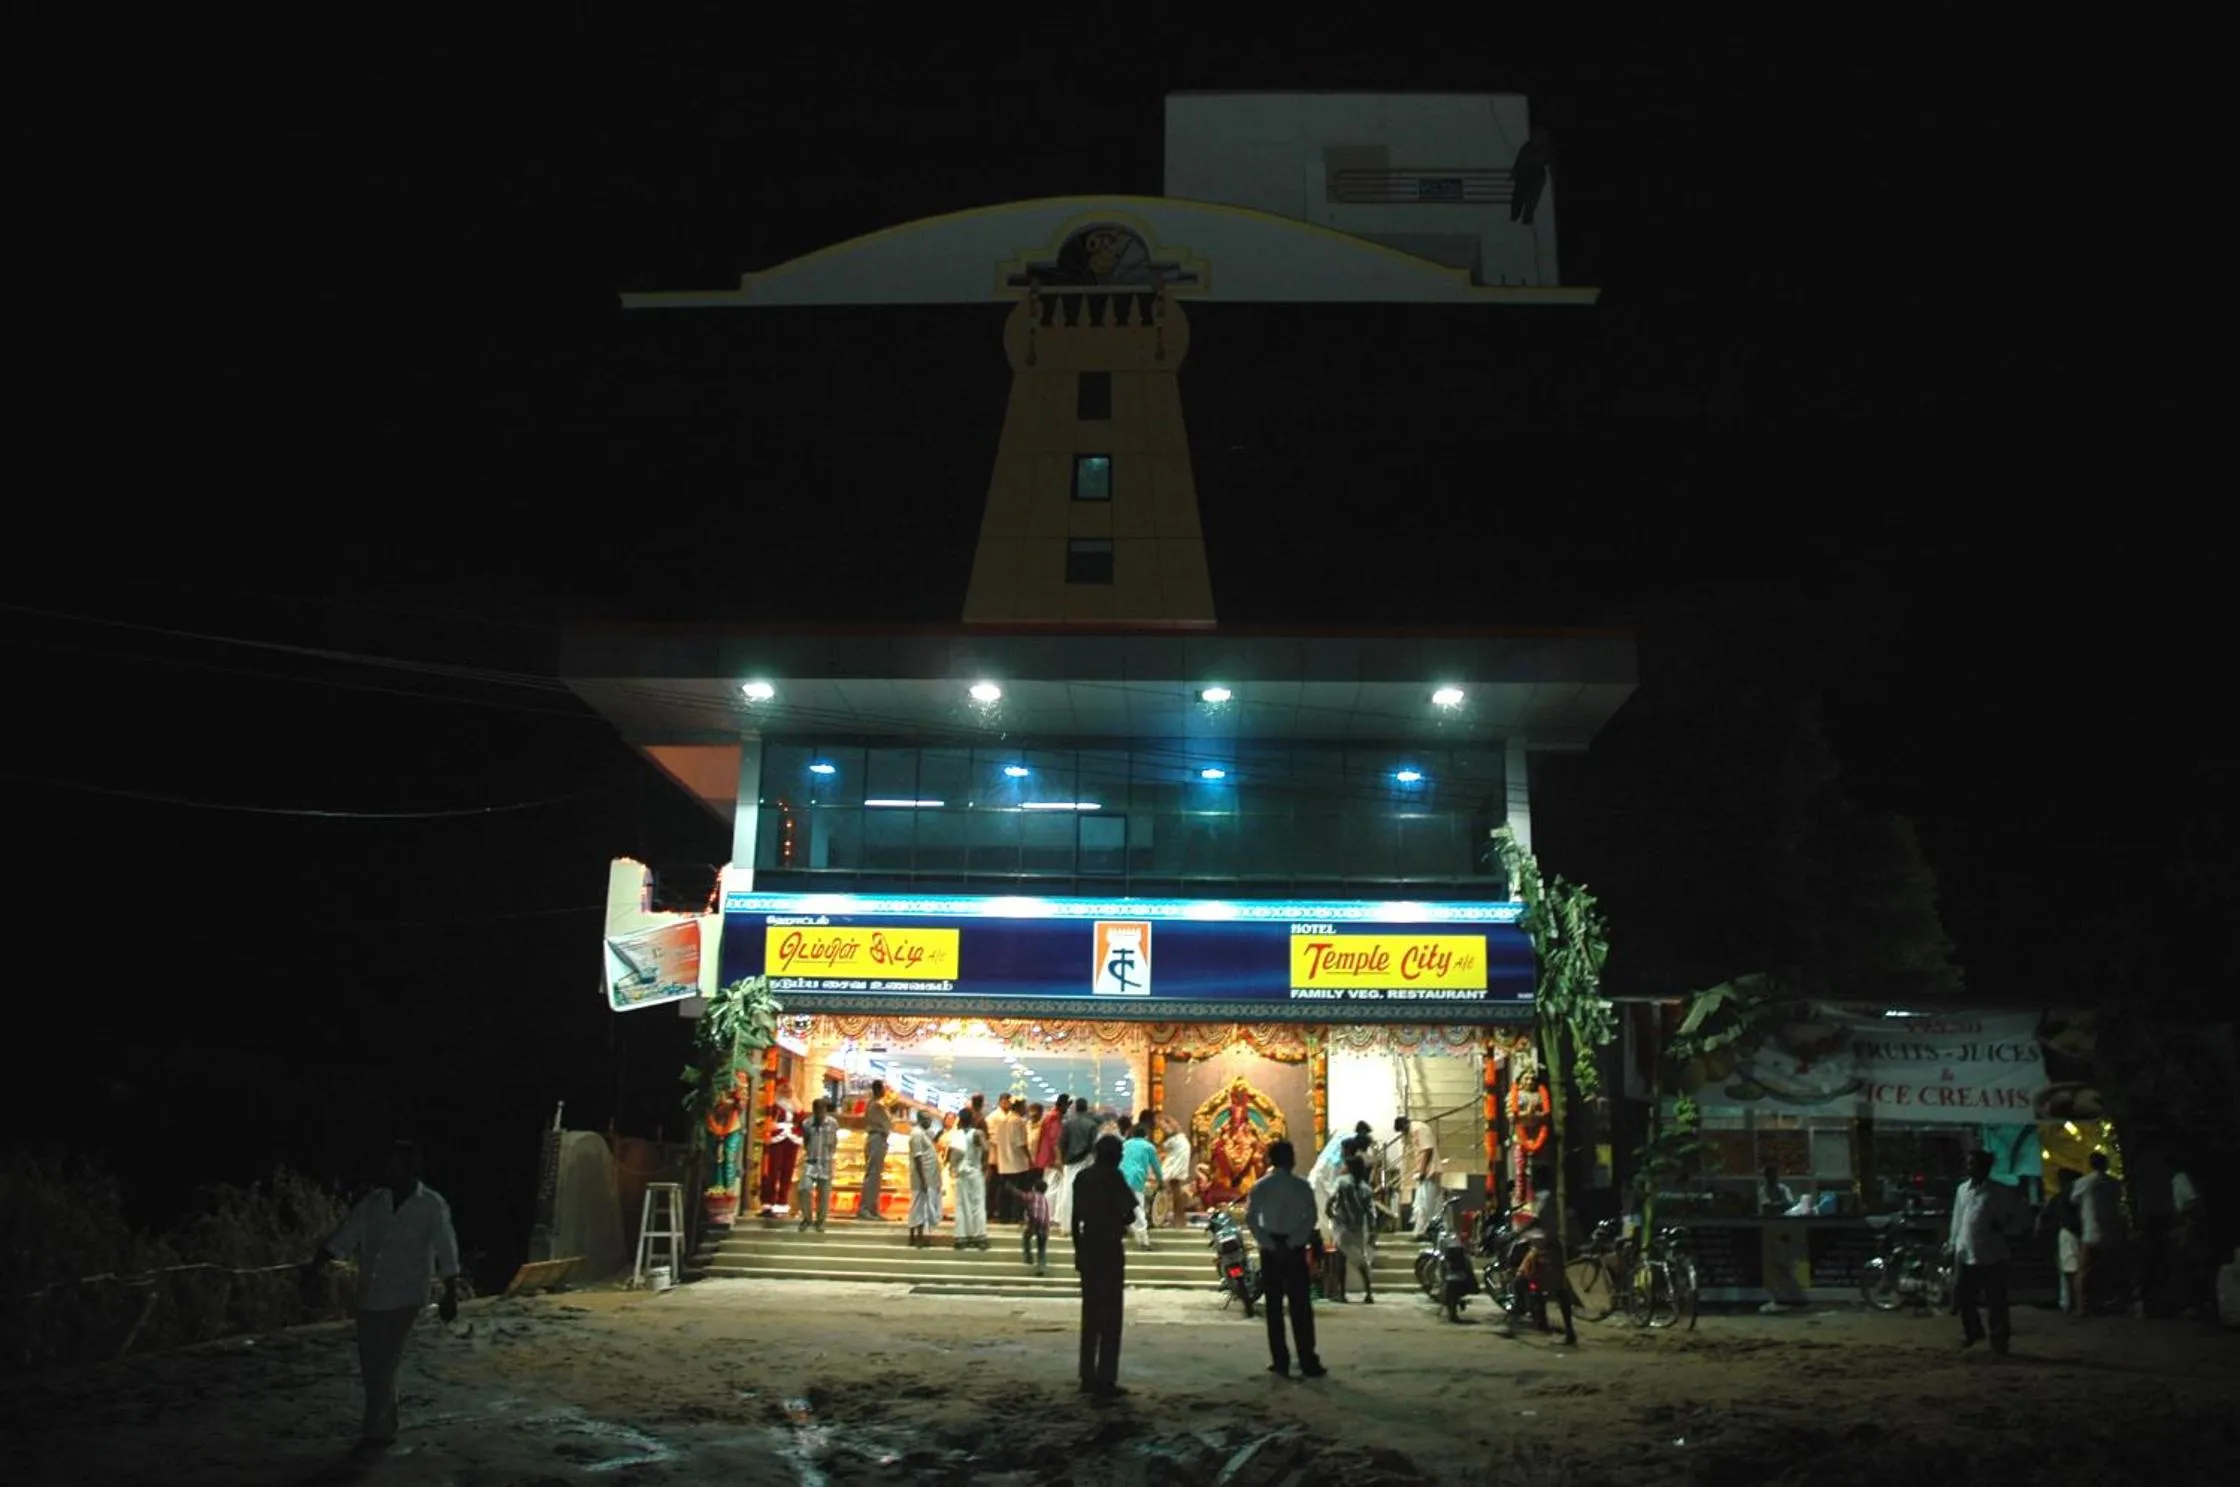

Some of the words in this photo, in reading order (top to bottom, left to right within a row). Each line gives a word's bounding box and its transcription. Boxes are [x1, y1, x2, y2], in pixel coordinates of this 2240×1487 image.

[1291, 923, 1337, 934] HOTEL
[1303, 943, 1391, 980] Temple
[1400, 943, 1453, 980] City
[1290, 988, 1343, 998] FAMILY
[1347, 989, 1384, 999] VEG.
[1387, 989, 1488, 1000] RESTAURANT
[1940, 1067, 1954, 1080] &
[1866, 1083, 1912, 1105] ICE
[1918, 1086, 2030, 1108] CREAMS
